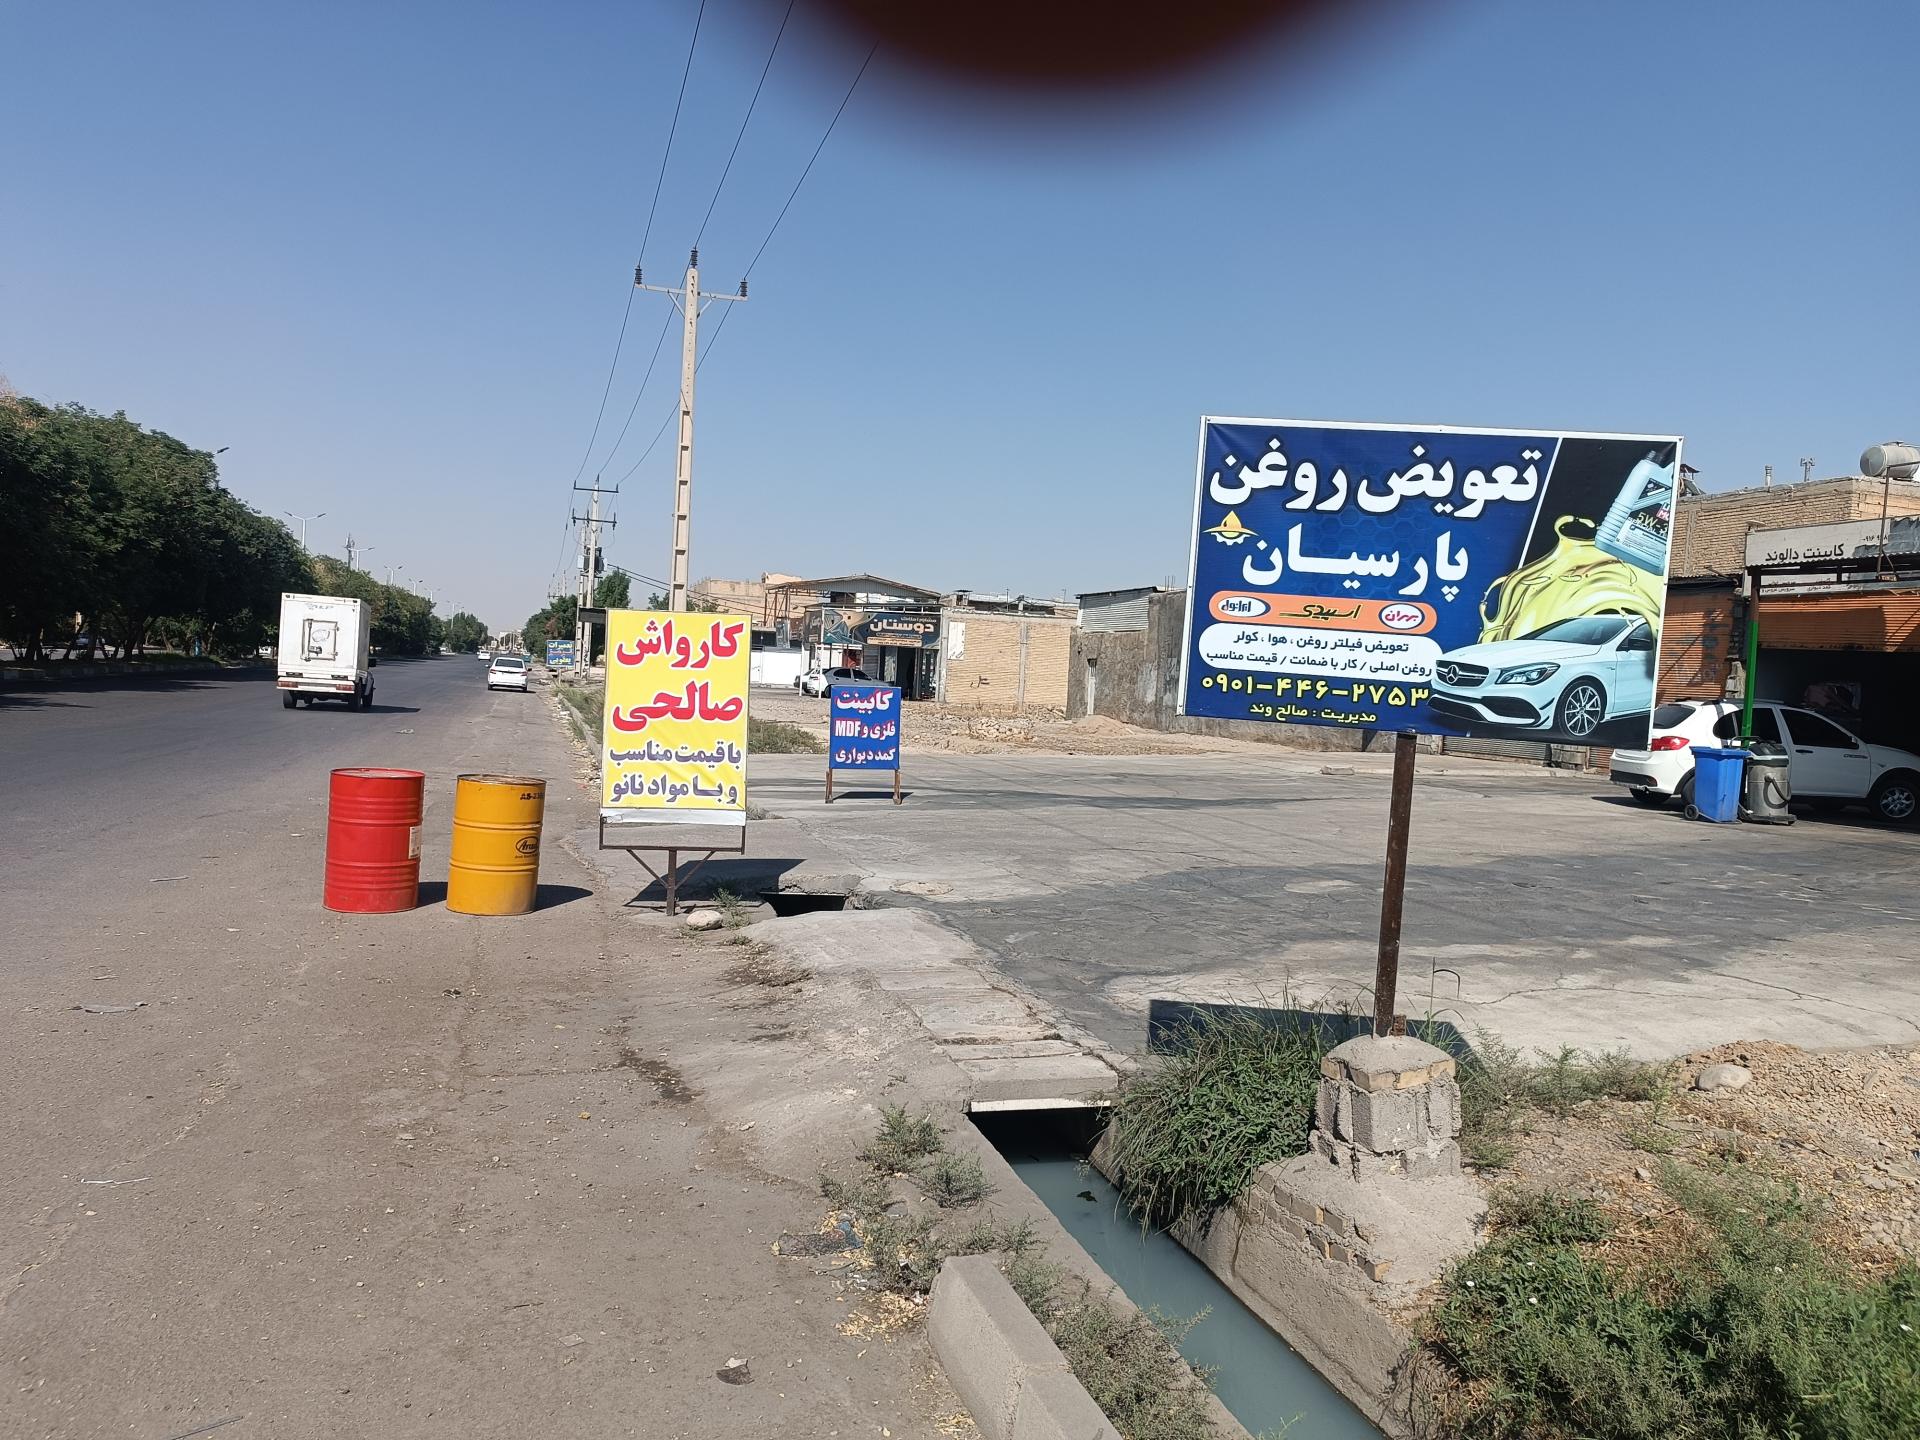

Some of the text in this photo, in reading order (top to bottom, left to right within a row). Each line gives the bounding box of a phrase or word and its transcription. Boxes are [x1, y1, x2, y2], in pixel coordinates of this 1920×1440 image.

[1210, 438, 1538, 518] تعویض روغن
[1242, 522, 1469, 602] پارسیان
[1280, 604, 1361, 621] اسپیدی
[1385, 610, 1419, 622] بهران
[870, 618, 934, 634] دوستان
[616, 620, 745, 668] کارواش
[1233, 631, 1259, 644] کولر
[1268, 633, 1287, 646] هوا
[1296, 635, 1328, 649] روغن
[1330, 638, 1363, 651] فیلتر
[1365, 640, 1409, 654] تعویض
[1206, 651, 1244, 661] مناسب
[1246, 653, 1278, 665] قیمت
[1290, 656, 1328, 667] ضمانت
[1330, 658, 1339, 670] با
[1340, 659, 1358, 670] کار
[1370, 661, 1400, 673] اصلی
[1402, 663, 1432, 676] روغن
[1202, 673, 1430, 706] ۰۹۰۱-۴۴۶-۲۷۵۳
[612, 680, 743, 732] صالحی
[836, 690, 894, 714] کابینت
[1321, 709, 1377, 723] مدیریت
[835, 719, 861, 737] MDF
[869, 721, 896, 740] فلزی
[610, 740, 741, 769] با قیمت مناسب
[835, 748, 896, 764] کمد دیواری
[610, 773, 643, 802] نانو
[648, 774, 689, 802] مواد
